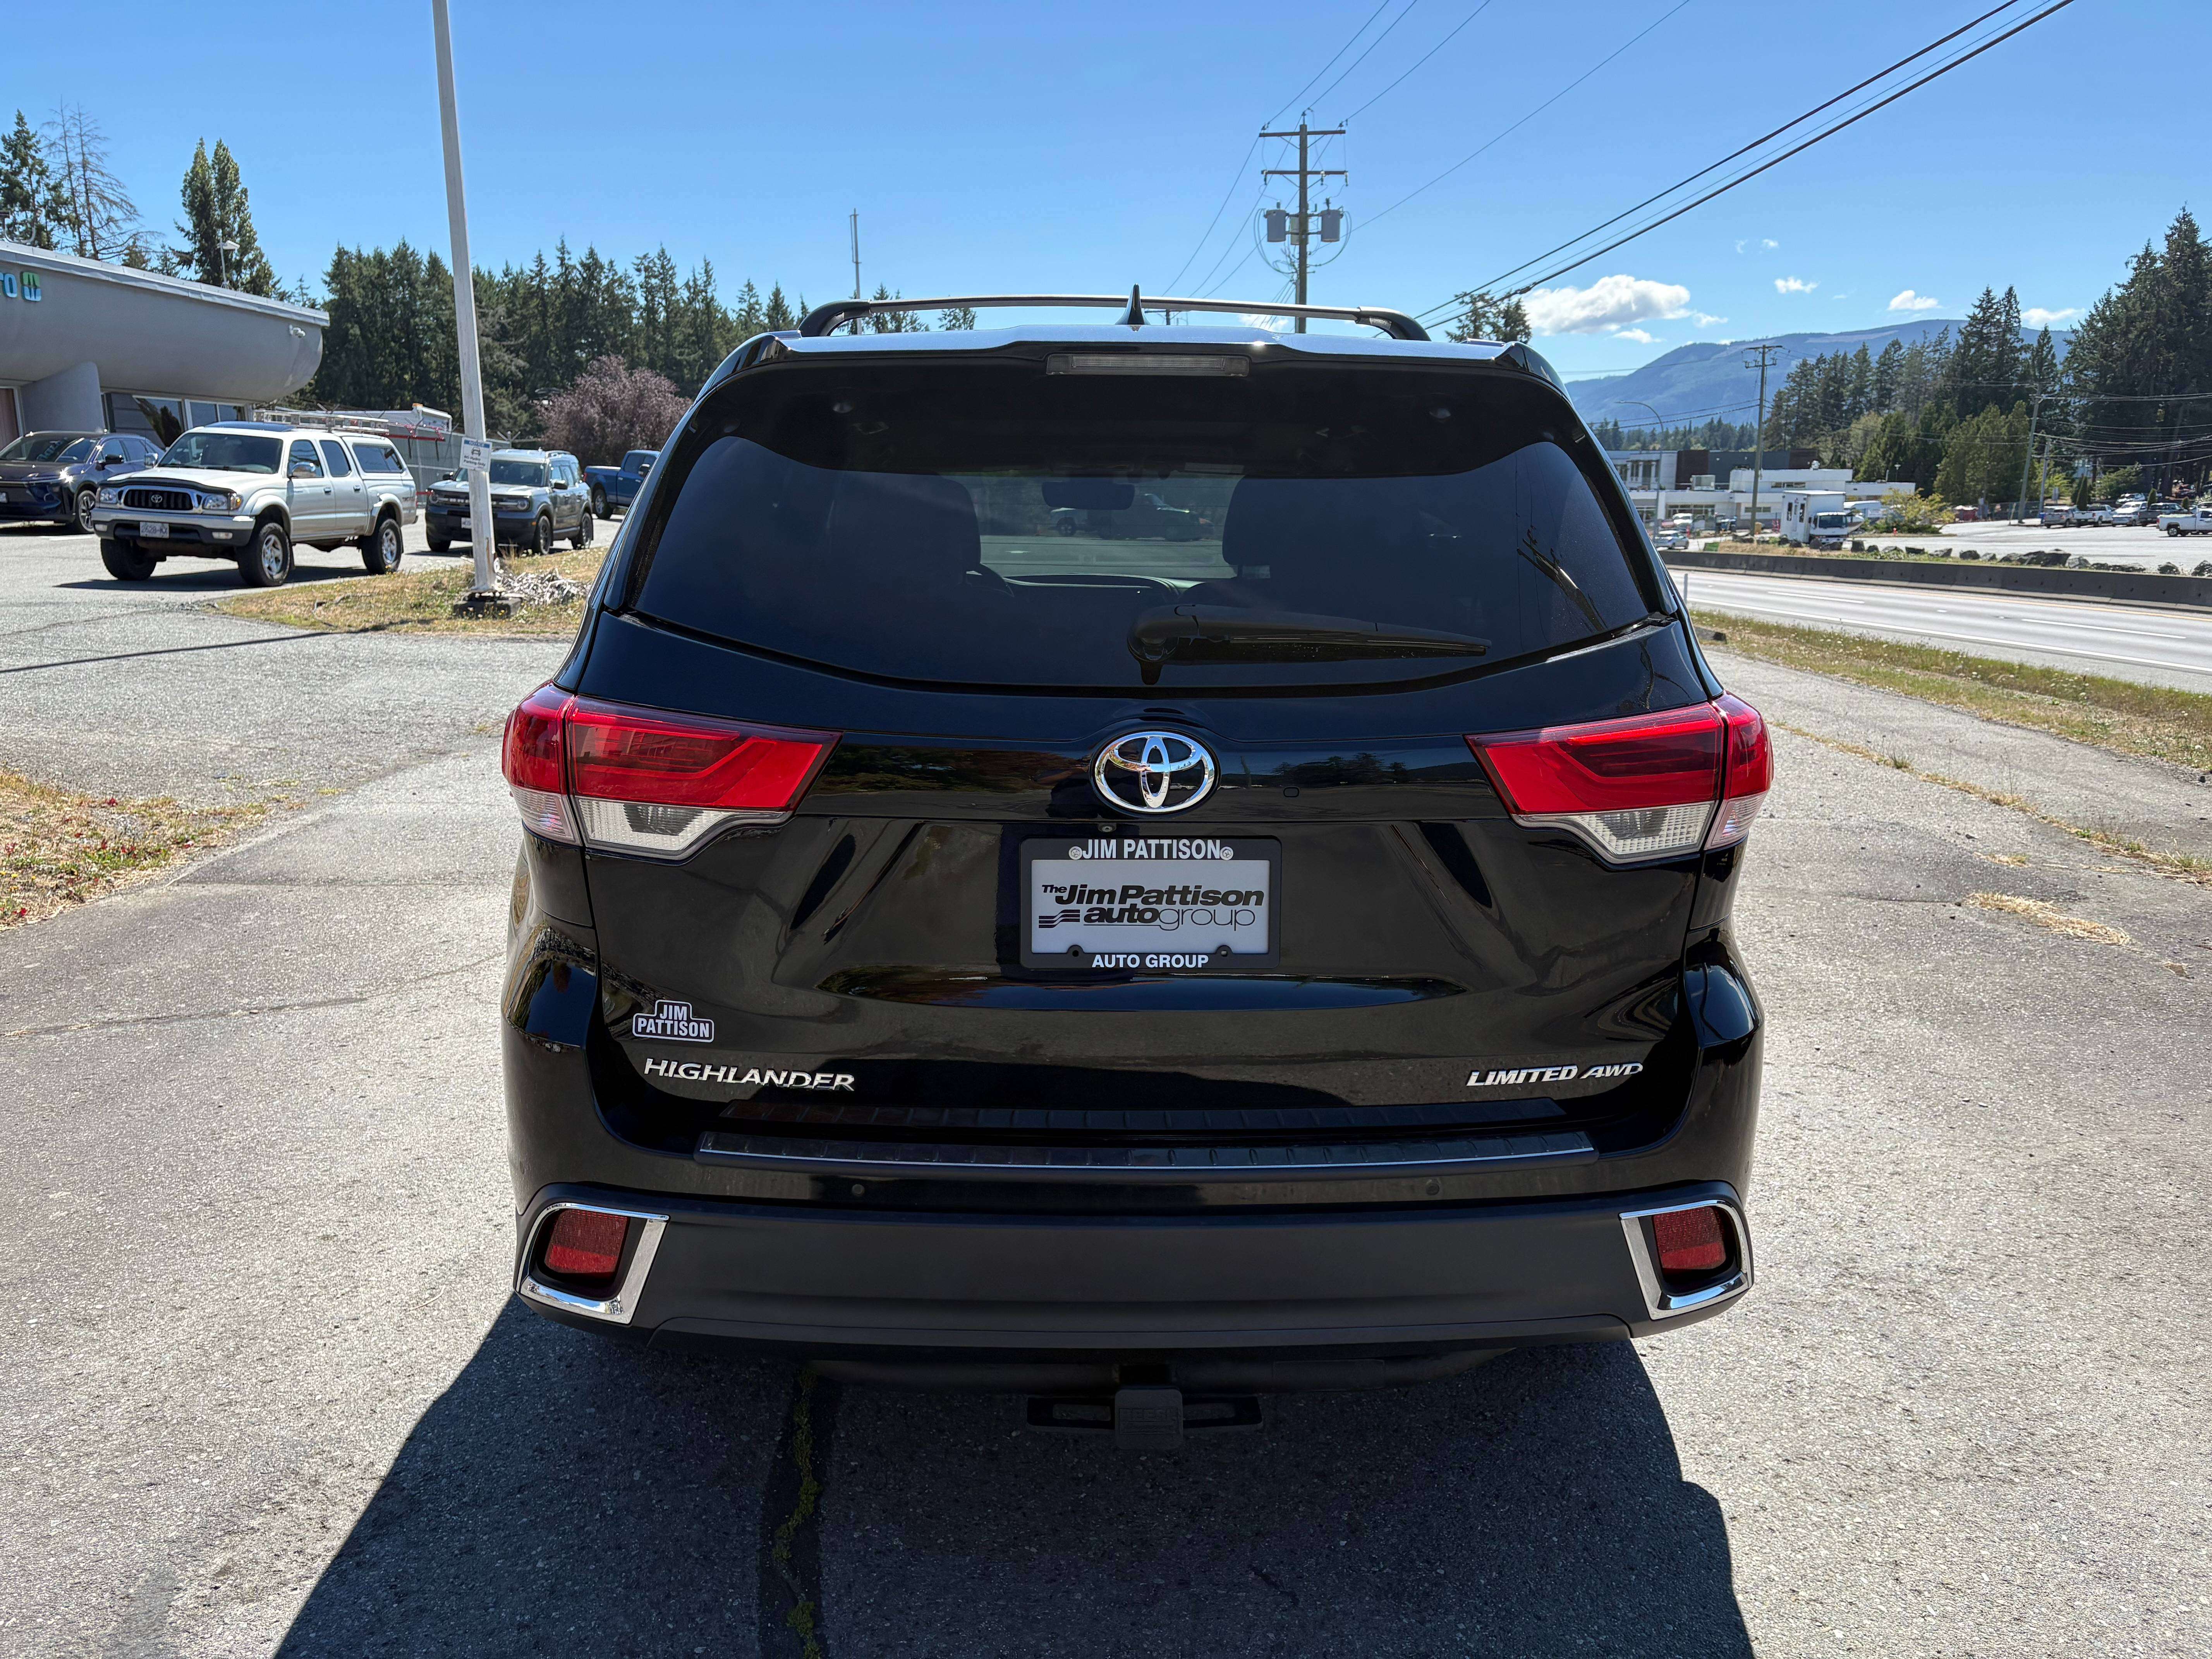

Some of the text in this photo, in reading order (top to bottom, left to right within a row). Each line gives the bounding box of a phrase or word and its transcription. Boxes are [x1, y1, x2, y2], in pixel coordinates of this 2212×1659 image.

[0, 273, 18, 298] o
[1082, 839, 1221, 859] JIM PATTISON
[1042, 884, 1264, 906] The Jim Pattison
[1092, 954, 1209, 967] AUTO GROUP
[659, 1005, 687, 1021] JIM
[637, 1018, 709, 1037] PATTISON
[644, 1058, 855, 1091] HIGHLANDER
[1466, 1062, 1644, 1086] LIMITED AWD
